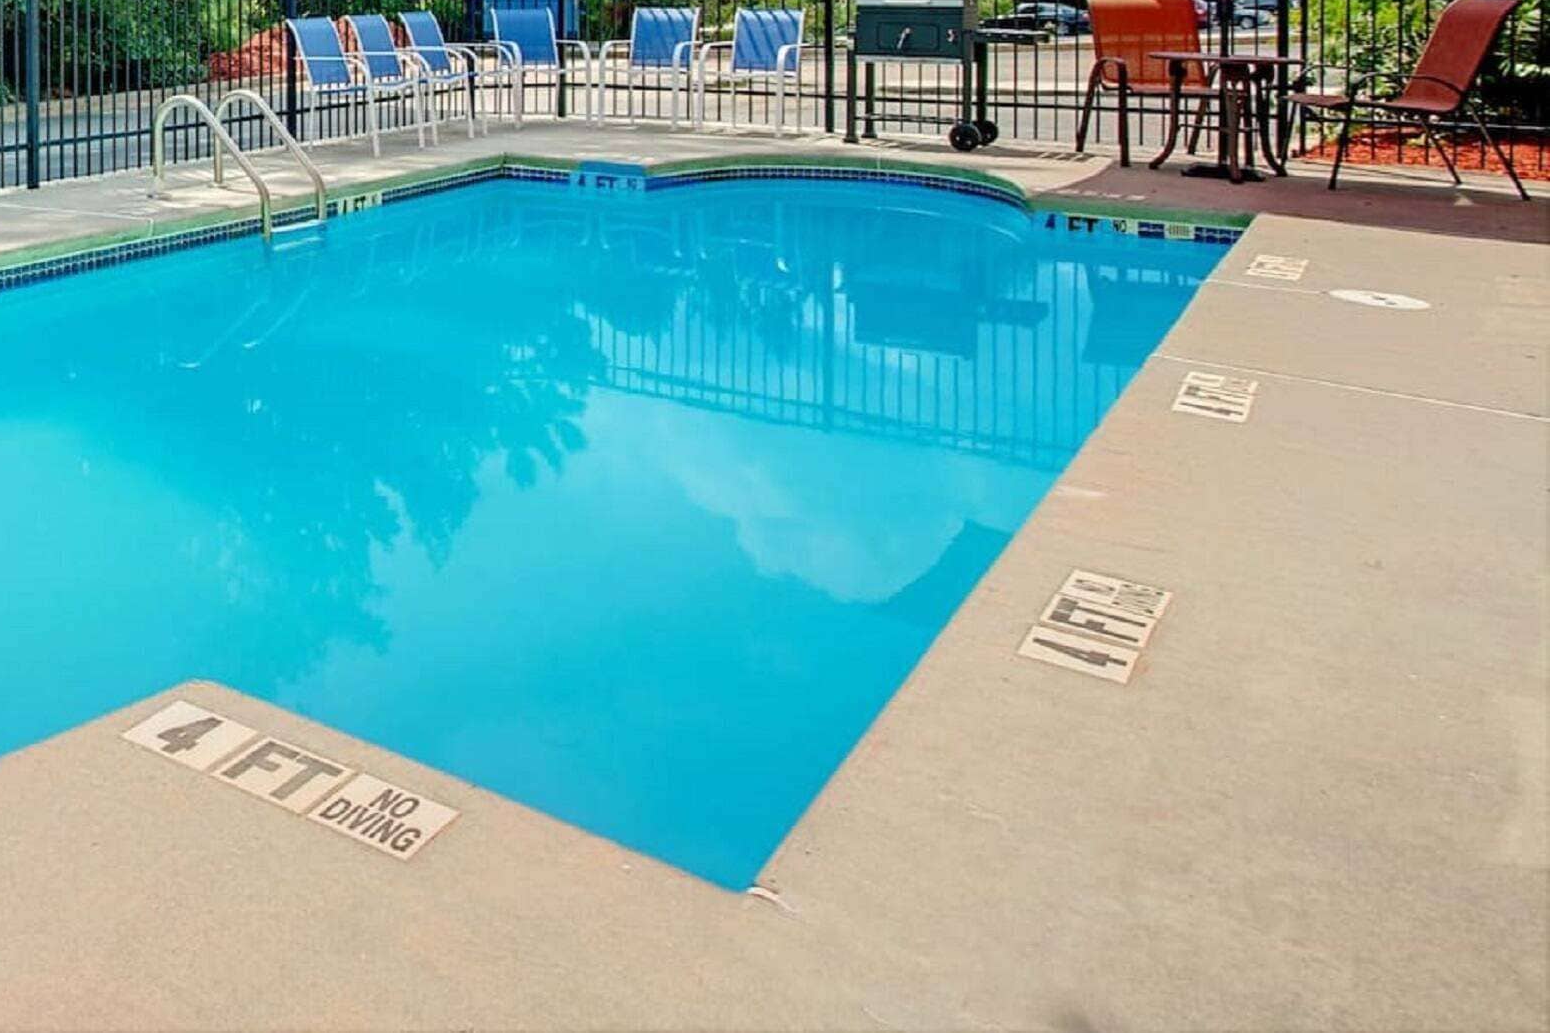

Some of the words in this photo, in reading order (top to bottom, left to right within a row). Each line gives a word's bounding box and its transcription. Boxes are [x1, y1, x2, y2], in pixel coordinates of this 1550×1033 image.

[1050, 597, 1148, 643] FT
[1032, 637, 1128, 667] 4
[157, 717, 223, 754] 4
[221, 740, 343, 801] FT
[318, 798, 422, 853] DIVING
[368, 788, 420, 817] NO
